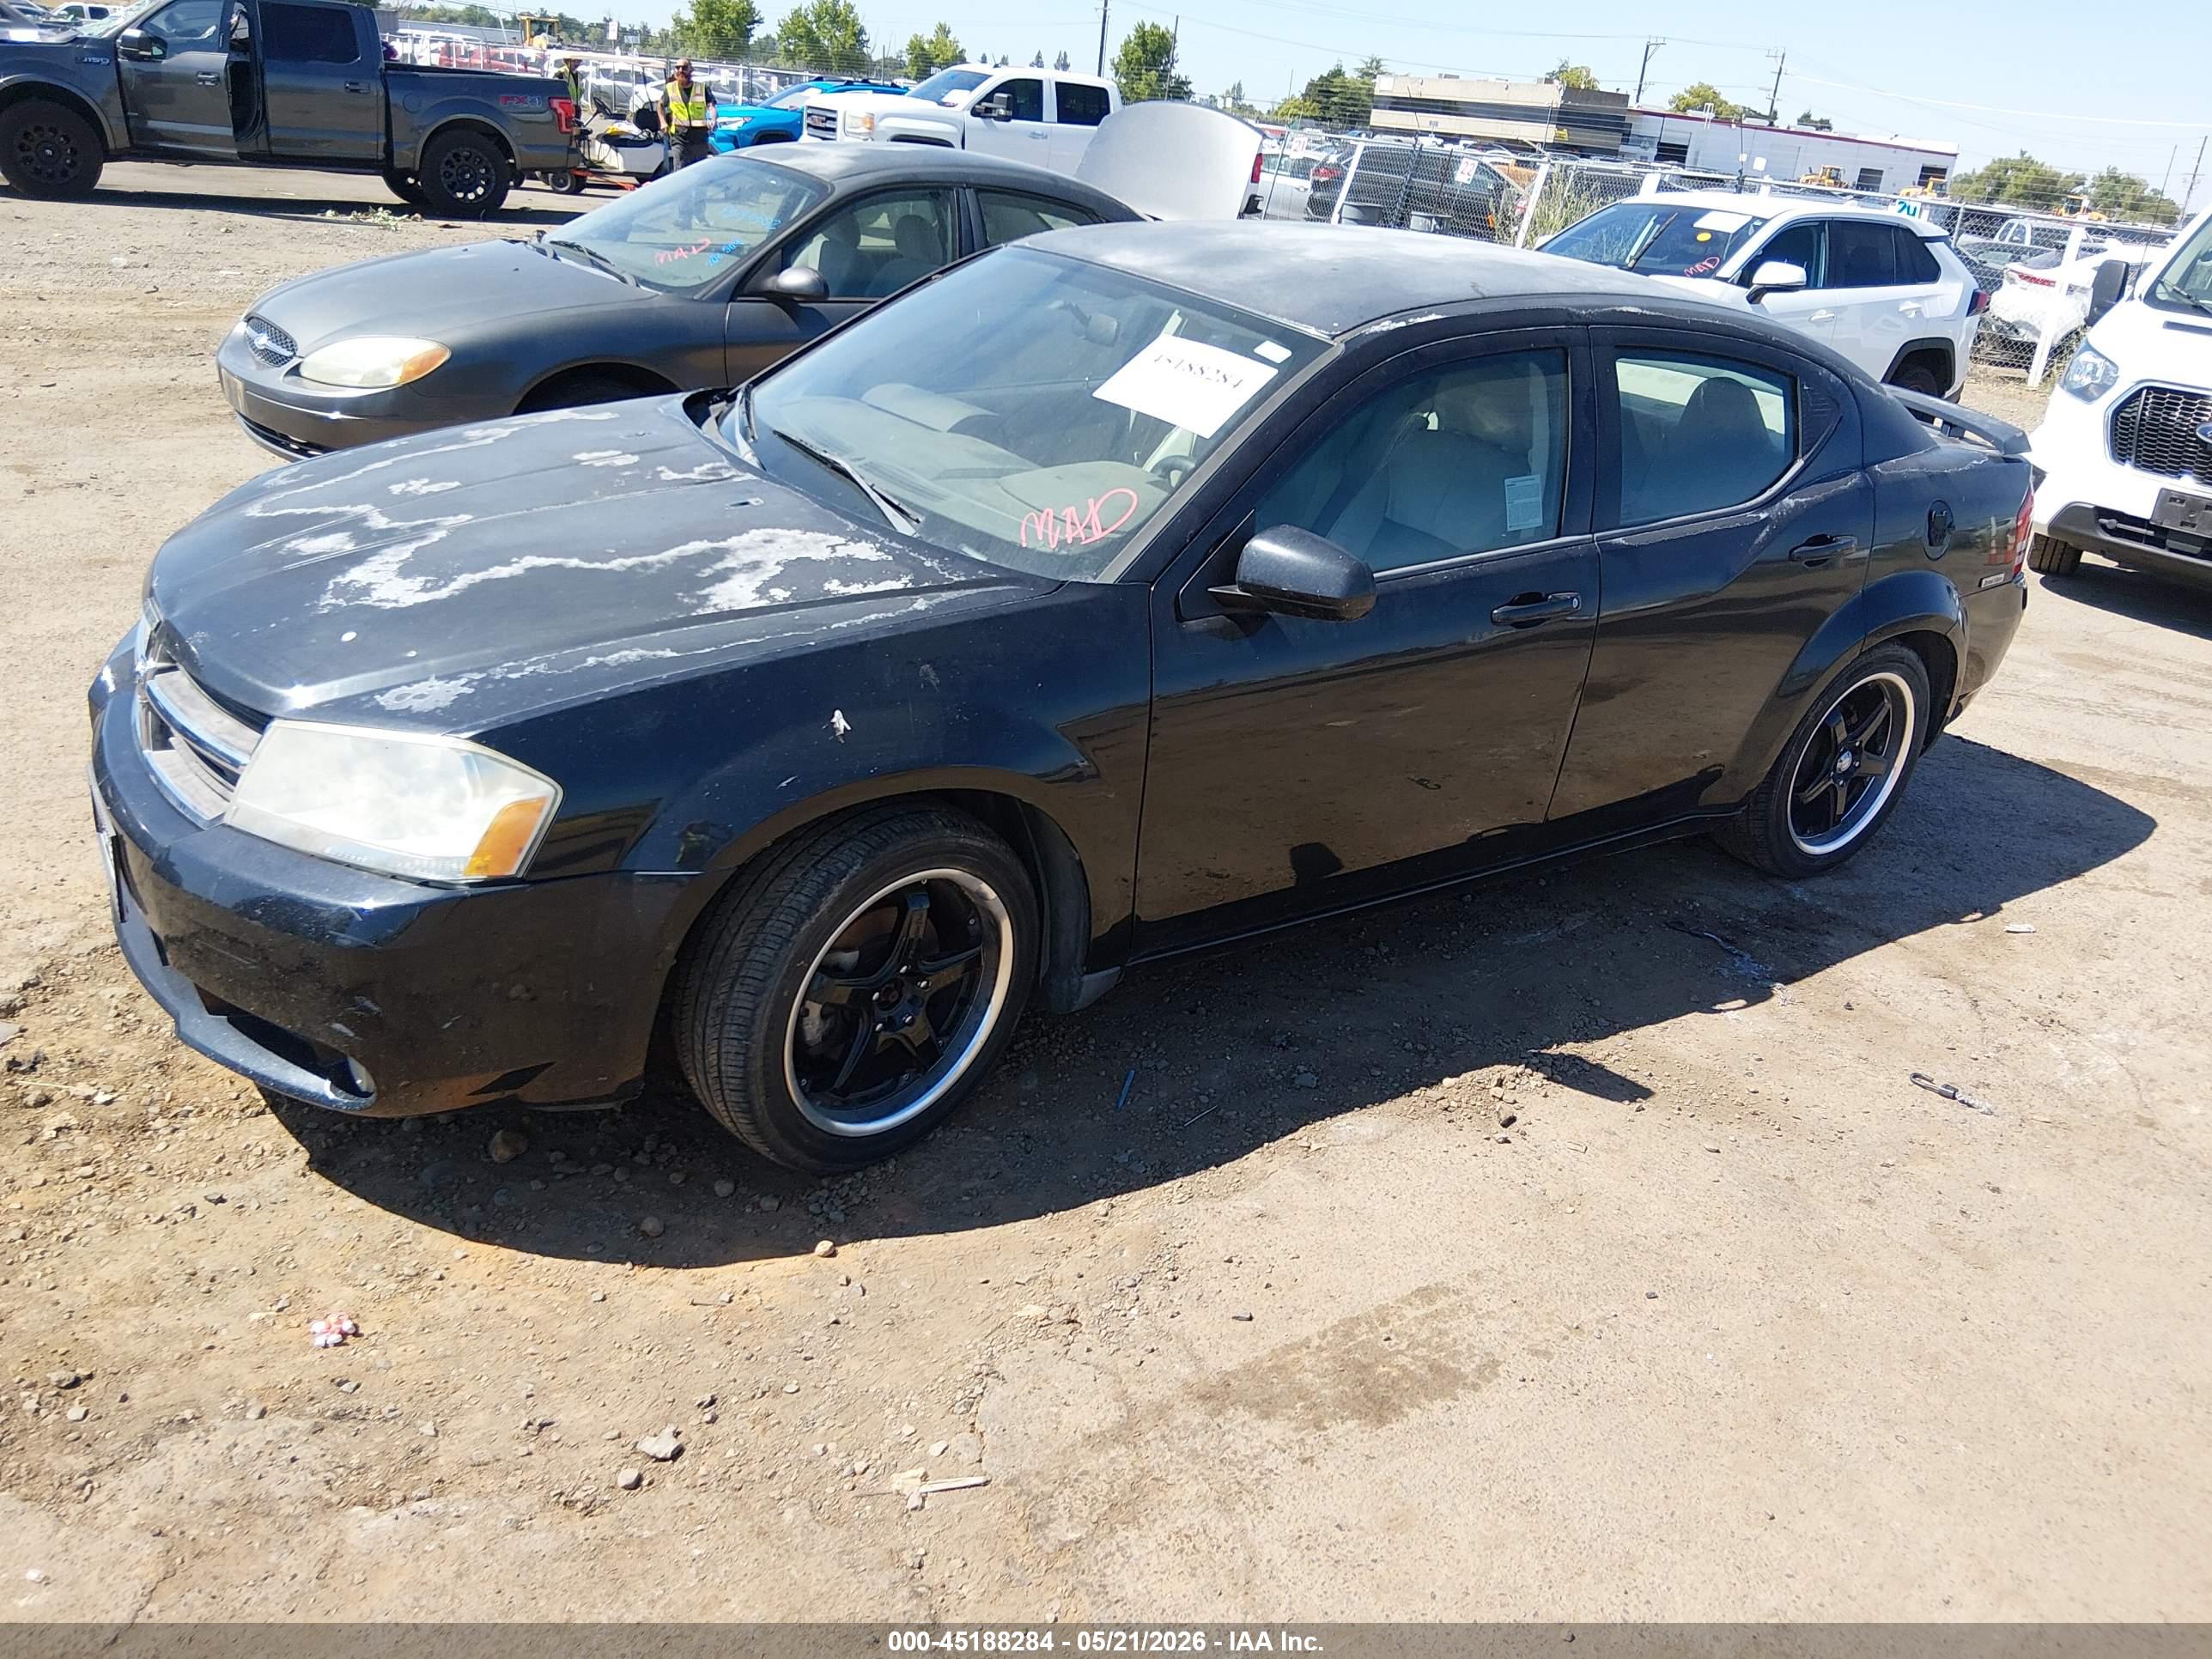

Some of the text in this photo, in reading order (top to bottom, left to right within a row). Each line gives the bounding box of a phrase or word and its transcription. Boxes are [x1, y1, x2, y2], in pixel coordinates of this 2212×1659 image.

[1460, 161, 1476, 177] 22
[1683, 256, 1721, 277] MAD
[1019, 487, 1139, 550] MAD
